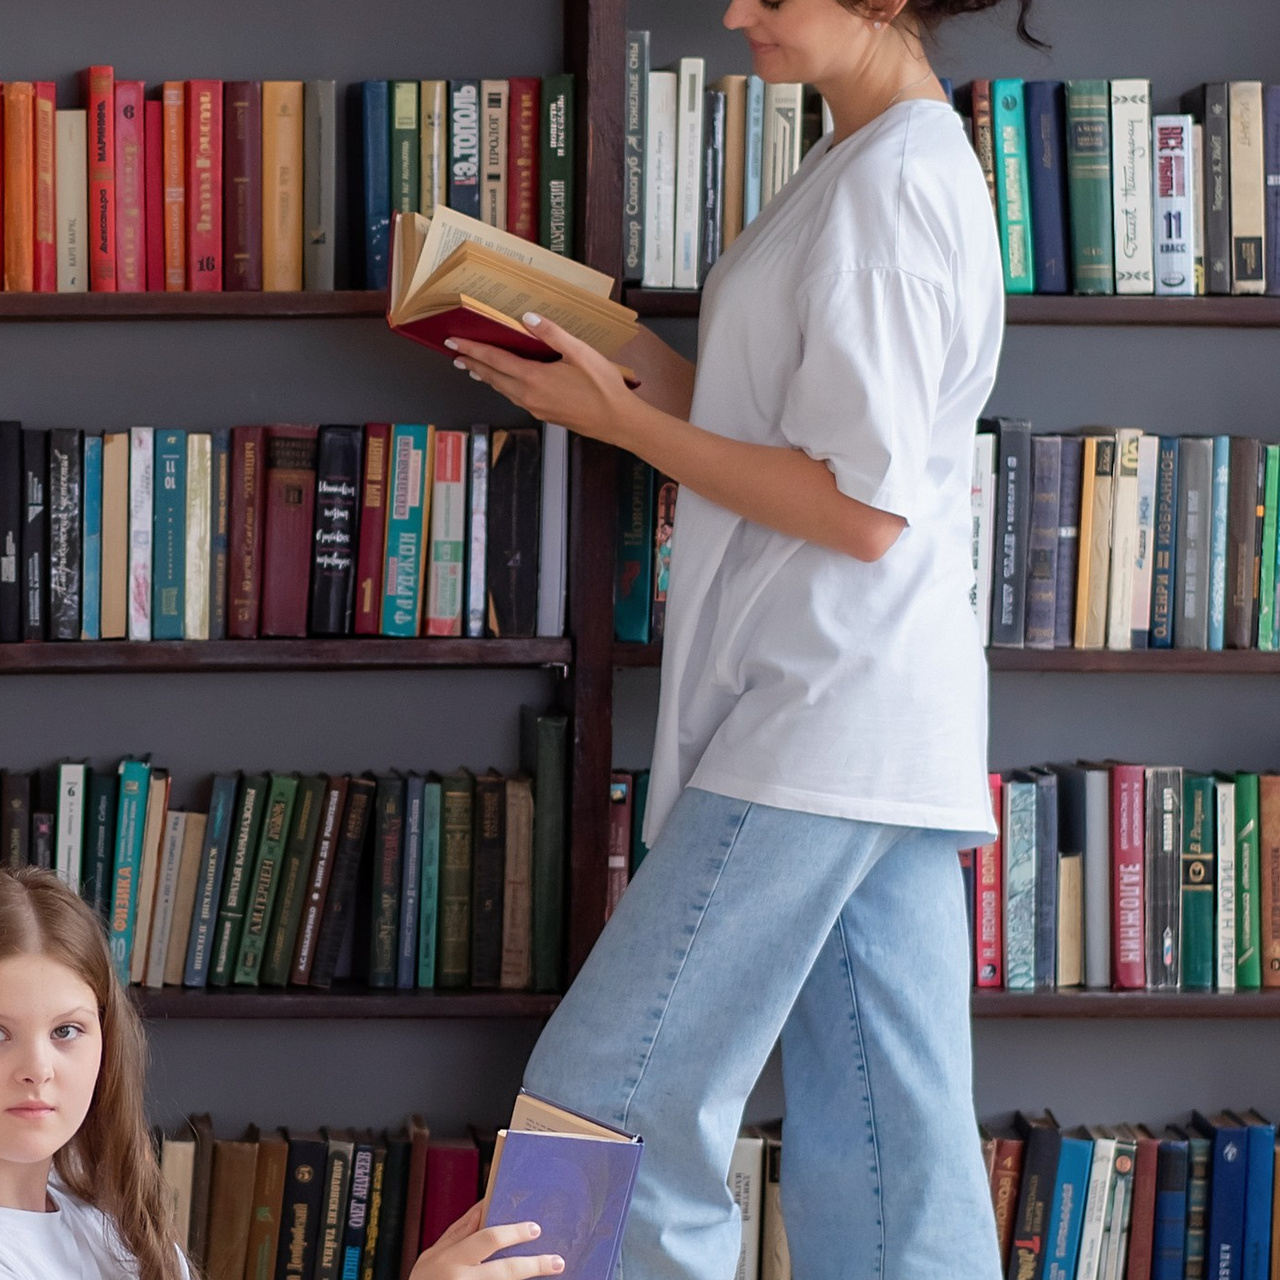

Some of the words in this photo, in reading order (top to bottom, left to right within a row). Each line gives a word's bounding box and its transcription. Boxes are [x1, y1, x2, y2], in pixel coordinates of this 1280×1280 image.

[628, 42, 639, 69] СНЫ
[628, 74, 640, 131] ТЯЖЕЛЫЕ
[96, 100, 106, 162] МАРИНИНА
[453, 85, 479, 176] Э.ТОПОЛЬ
[487, 114, 501, 166] ПРОЛОГ
[1212, 135, 1223, 160] УАЙТ
[626, 155, 643, 215] Сологуб
[1212, 163, 1223, 172] Х.
[1212, 176, 1223, 212] Теренс
[627, 220, 641, 268] Федор
[1157, 450, 1173, 545] ИЗБРАННОЕ
[393, 531, 417, 625] ФАРДЖОН
[1154, 574, 1169, 621] ГЕНРИ
[1154, 621, 1167, 638] О.
[322, 789, 340, 838] РОДИТЕЛЕЙ
[226, 867, 244, 907] БРАТЬЯ
[235, 787, 257, 866] КАРАМАЗОВЫ
[318, 840, 329, 860] ДЛЯ
[250, 858, 275, 936] А.И.ГЕРЦЕН
[314, 862, 325, 887] КНИГА
[114, 866, 133, 932] ФИЗИКА
[981, 891, 996, 941] ЛЕОНОВ
[982, 946, 996, 958] Н.
[1221, 935, 1234, 975] ЛИЦУ
[325, 1159, 343, 1226] ЛОНДОНСКИЕ
[351, 1151, 372, 1198] АНДРЕЕВ
[347, 1200, 366, 1228] ОЛЕГ
[323, 1230, 337, 1268] ТАЙНЫ
